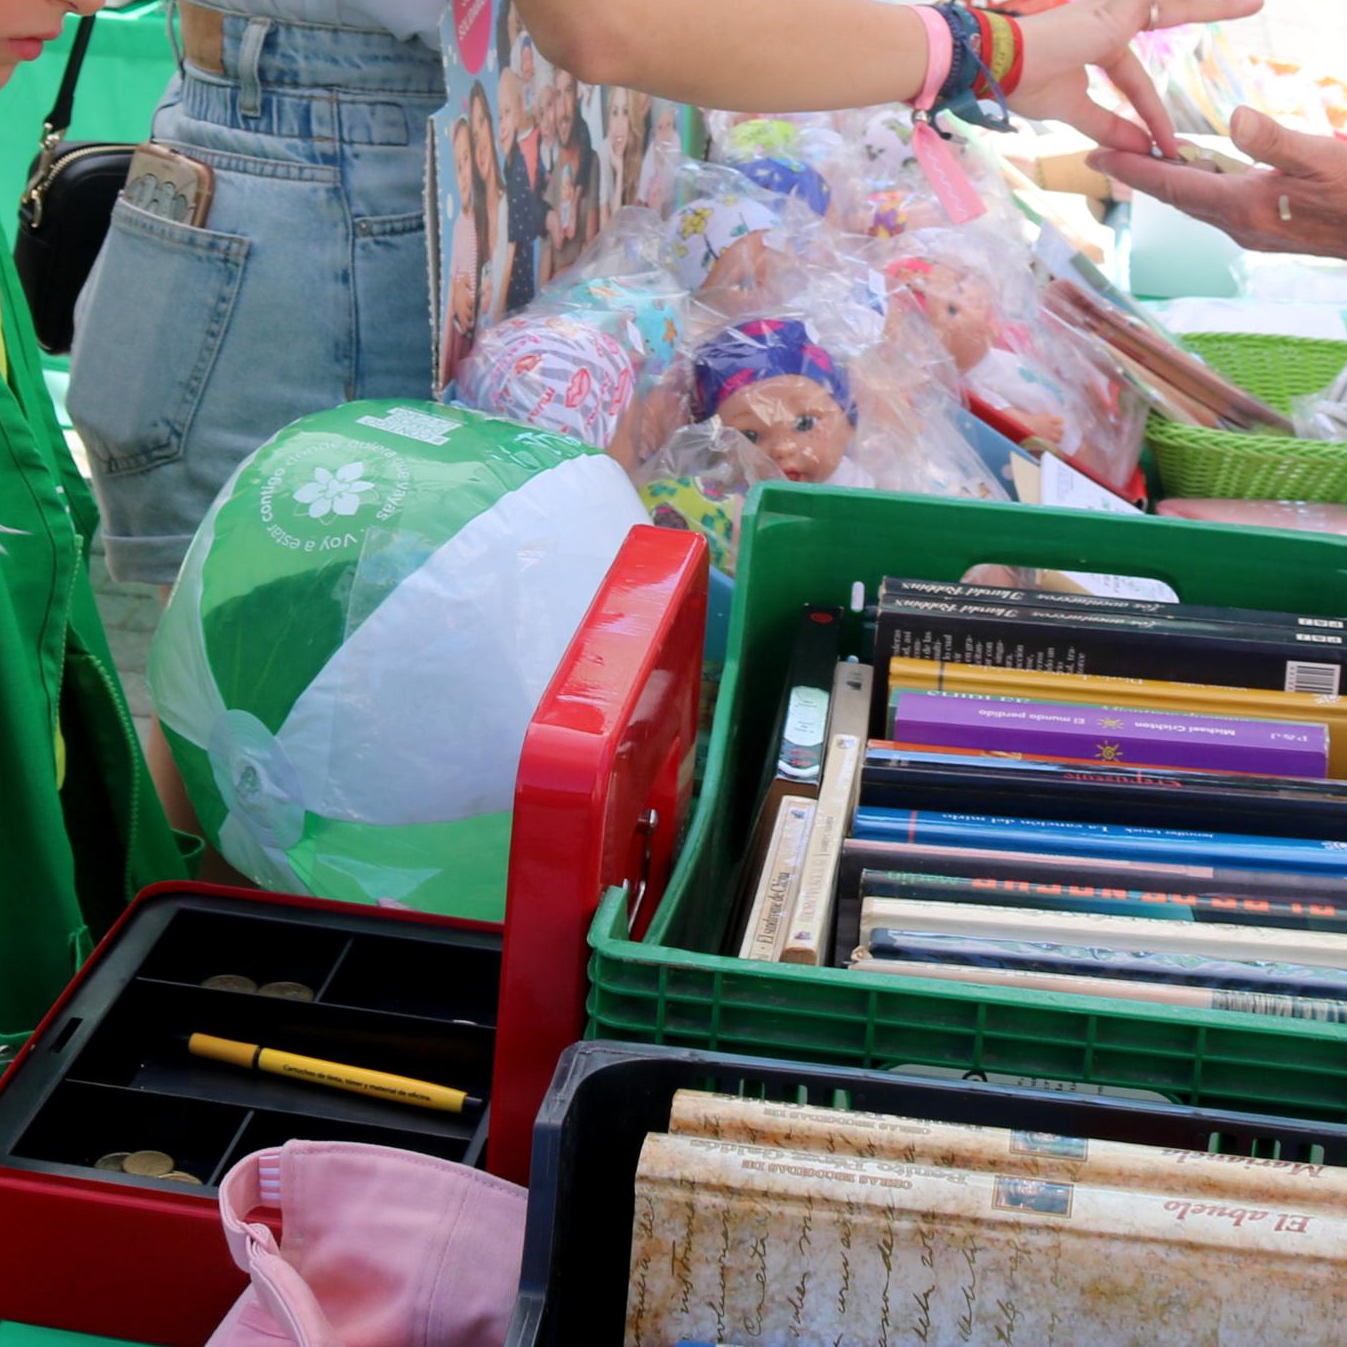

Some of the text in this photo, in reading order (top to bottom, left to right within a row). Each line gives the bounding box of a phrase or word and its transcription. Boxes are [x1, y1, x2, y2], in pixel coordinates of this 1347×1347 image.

[259, 465, 286, 524] contigo
[375, 480, 412, 523] vayas
[266, 524, 302, 553] estar
[304, 539, 316, 553] a
[319, 532, 358, 552] Voy
[900, 580, 963, 596] Robbins
[965, 585, 1025, 602] Harold
[894, 598, 958, 614] Robbins
[961, 604, 1020, 619] Harold
[977, 709, 1026, 722] perdido
[1028, 712, 1070, 724] mundo
[1072, 716, 1086, 726] El
[1134, 719, 1186, 734] Crichton
[1189, 723, 1236, 737] Michael
[790, 1112, 876, 1131] ESCOGIDAS
[879, 1121, 933, 1136] OBRAS
[741, 1159, 913, 1190] OBRAS ESCOGIDAS DE
[877, 1161, 969, 1186] Benito
[1162, 1197, 1315, 1235] El abuelo
